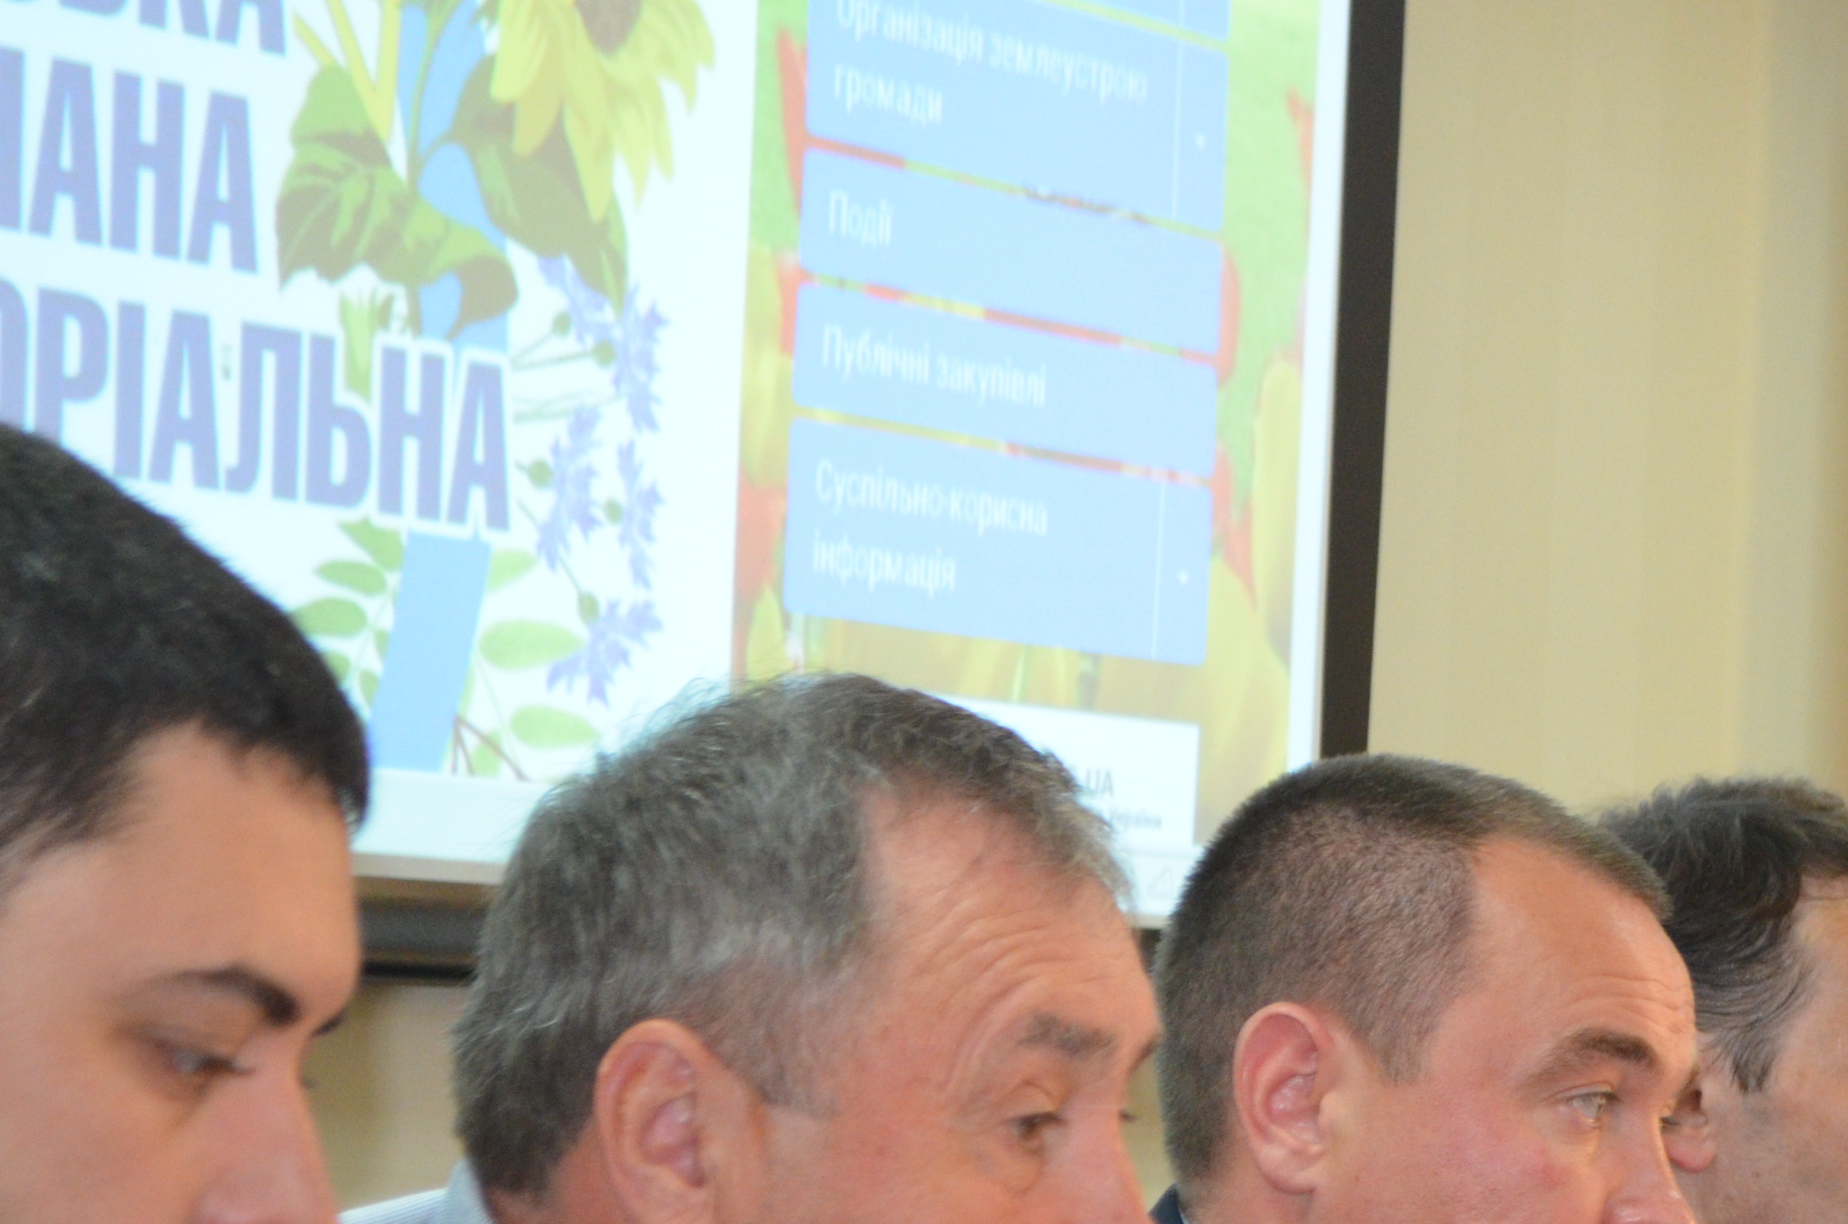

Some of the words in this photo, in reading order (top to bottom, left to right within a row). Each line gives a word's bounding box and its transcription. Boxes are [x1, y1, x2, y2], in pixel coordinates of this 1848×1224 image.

[834, 62, 944, 129] громади
[989, 31, 1149, 105] землеустрою
[828, 188, 893, 248] Події
[822, 321, 930, 386] Публічні
[936, 352, 1048, 409] закупівлі
[815, 460, 1049, 538] Суспільно-корисна
[813, 528, 957, 599] інформація
